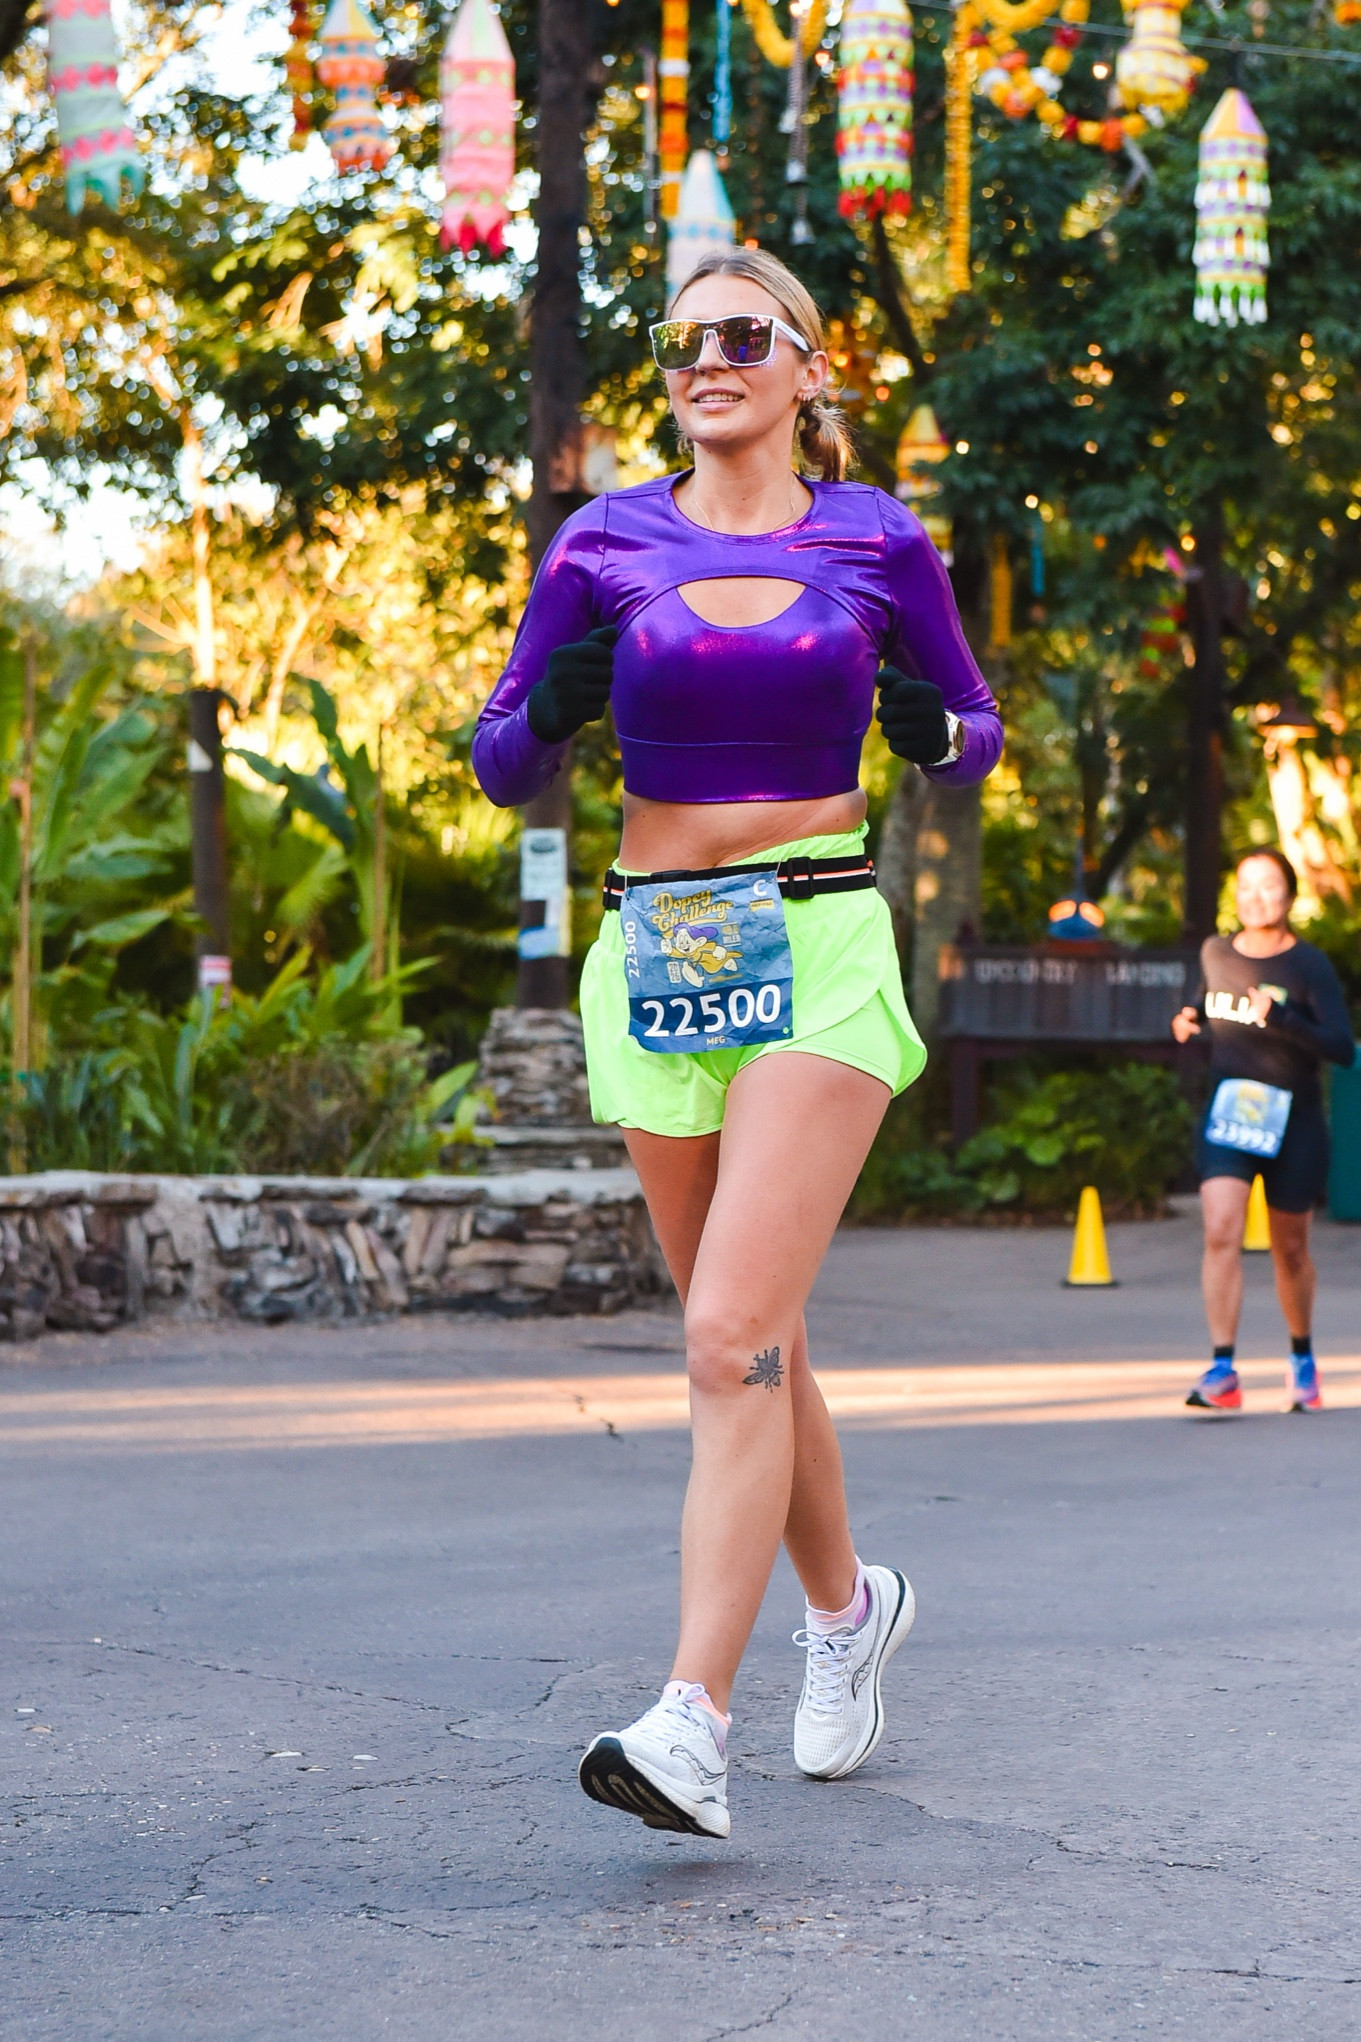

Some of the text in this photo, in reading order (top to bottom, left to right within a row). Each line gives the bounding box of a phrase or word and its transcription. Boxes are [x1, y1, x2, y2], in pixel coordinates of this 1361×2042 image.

[652, 889, 713, 914] Dopey
[753, 879, 768, 896] C
[651, 900, 734, 932] Challenge
[625, 921, 640, 978] 22500
[641, 984, 782, 1038] 22500
